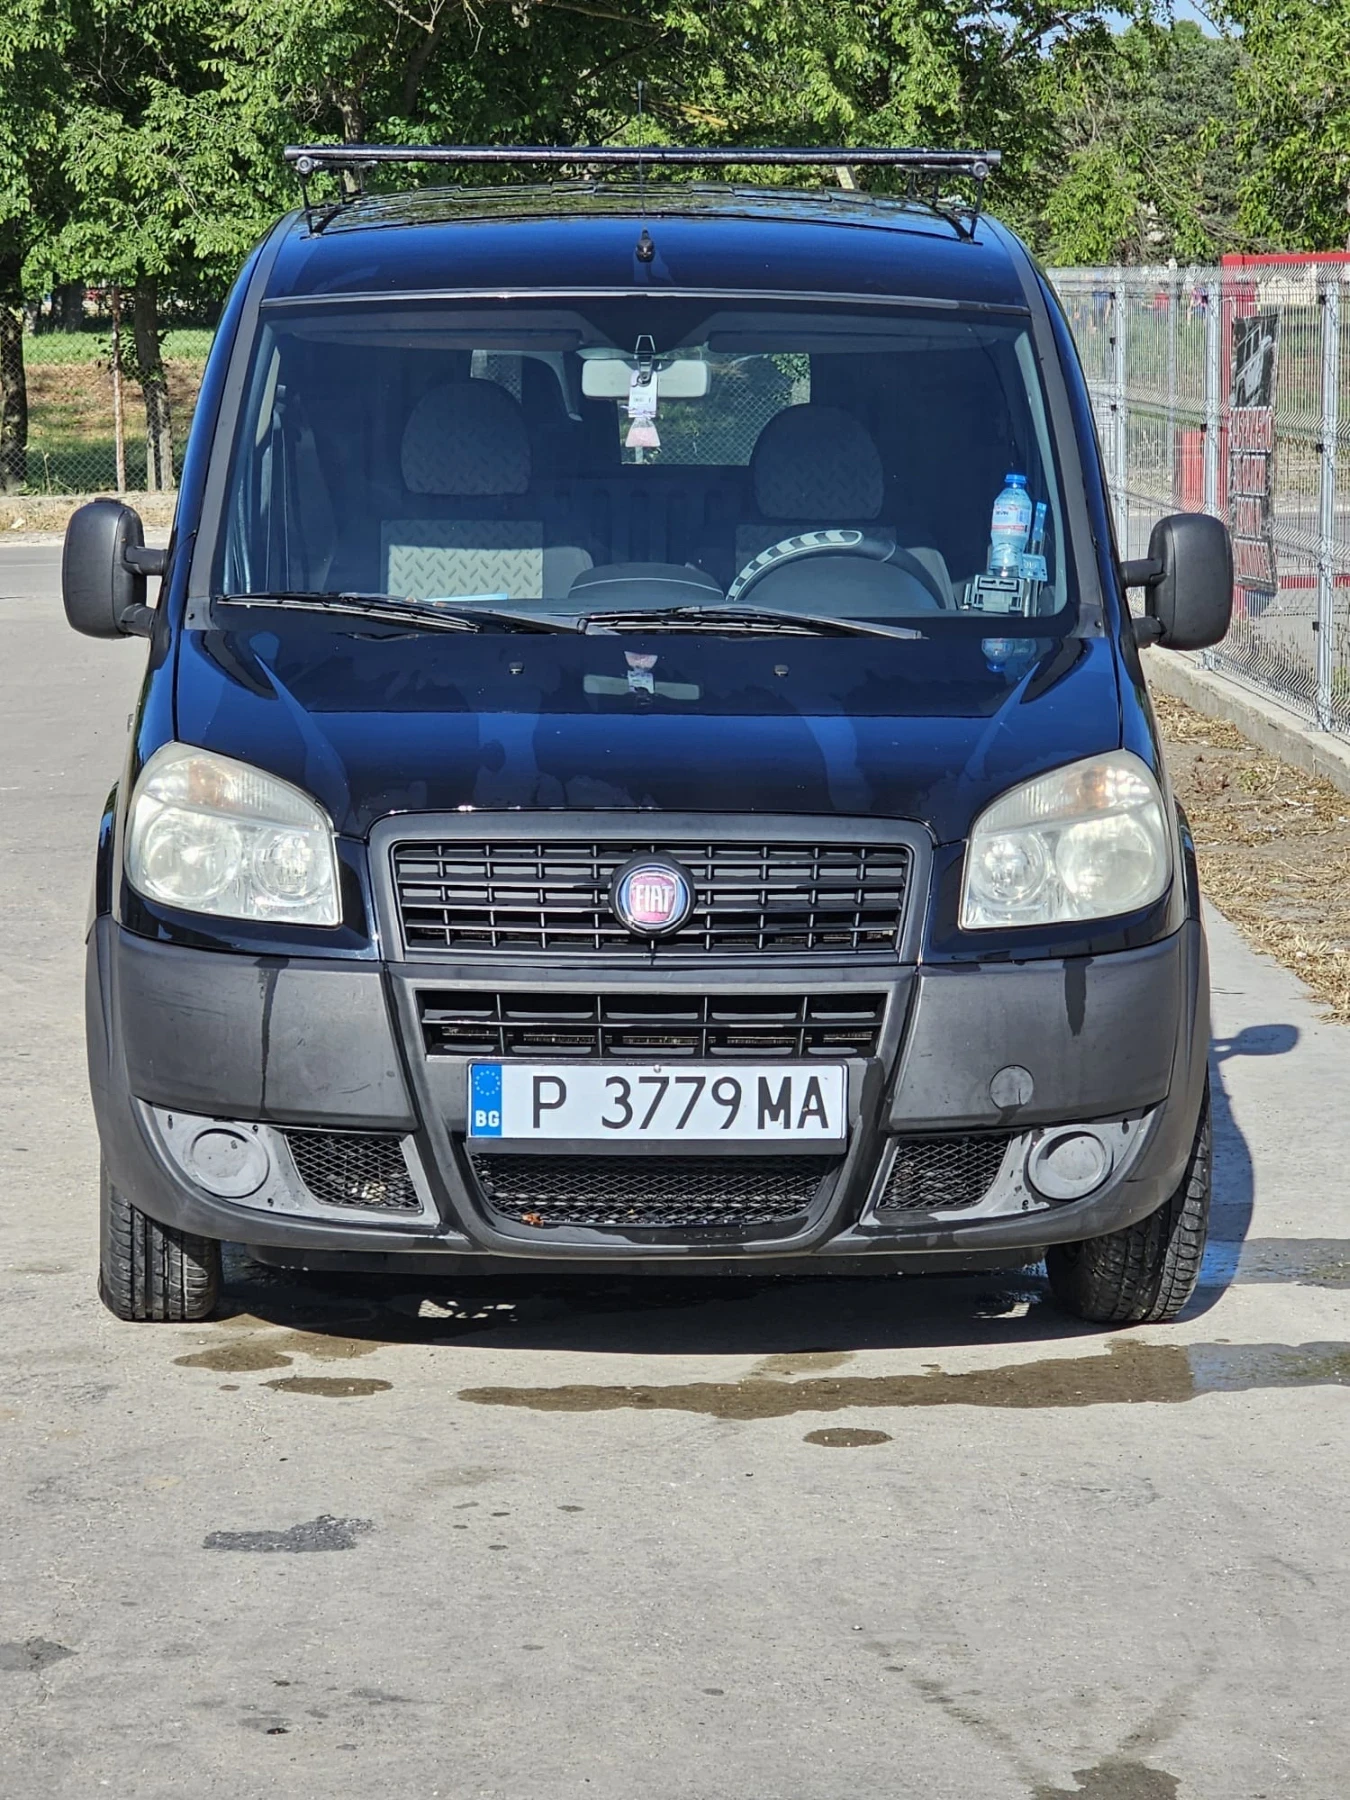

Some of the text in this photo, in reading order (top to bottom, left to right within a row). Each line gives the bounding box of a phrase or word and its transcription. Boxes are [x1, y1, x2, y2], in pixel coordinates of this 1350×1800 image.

[635, 884, 673, 913] FIAT
[533, 1076, 829, 1130] P 3779 MA
[475, 1110, 499, 1127] BG
